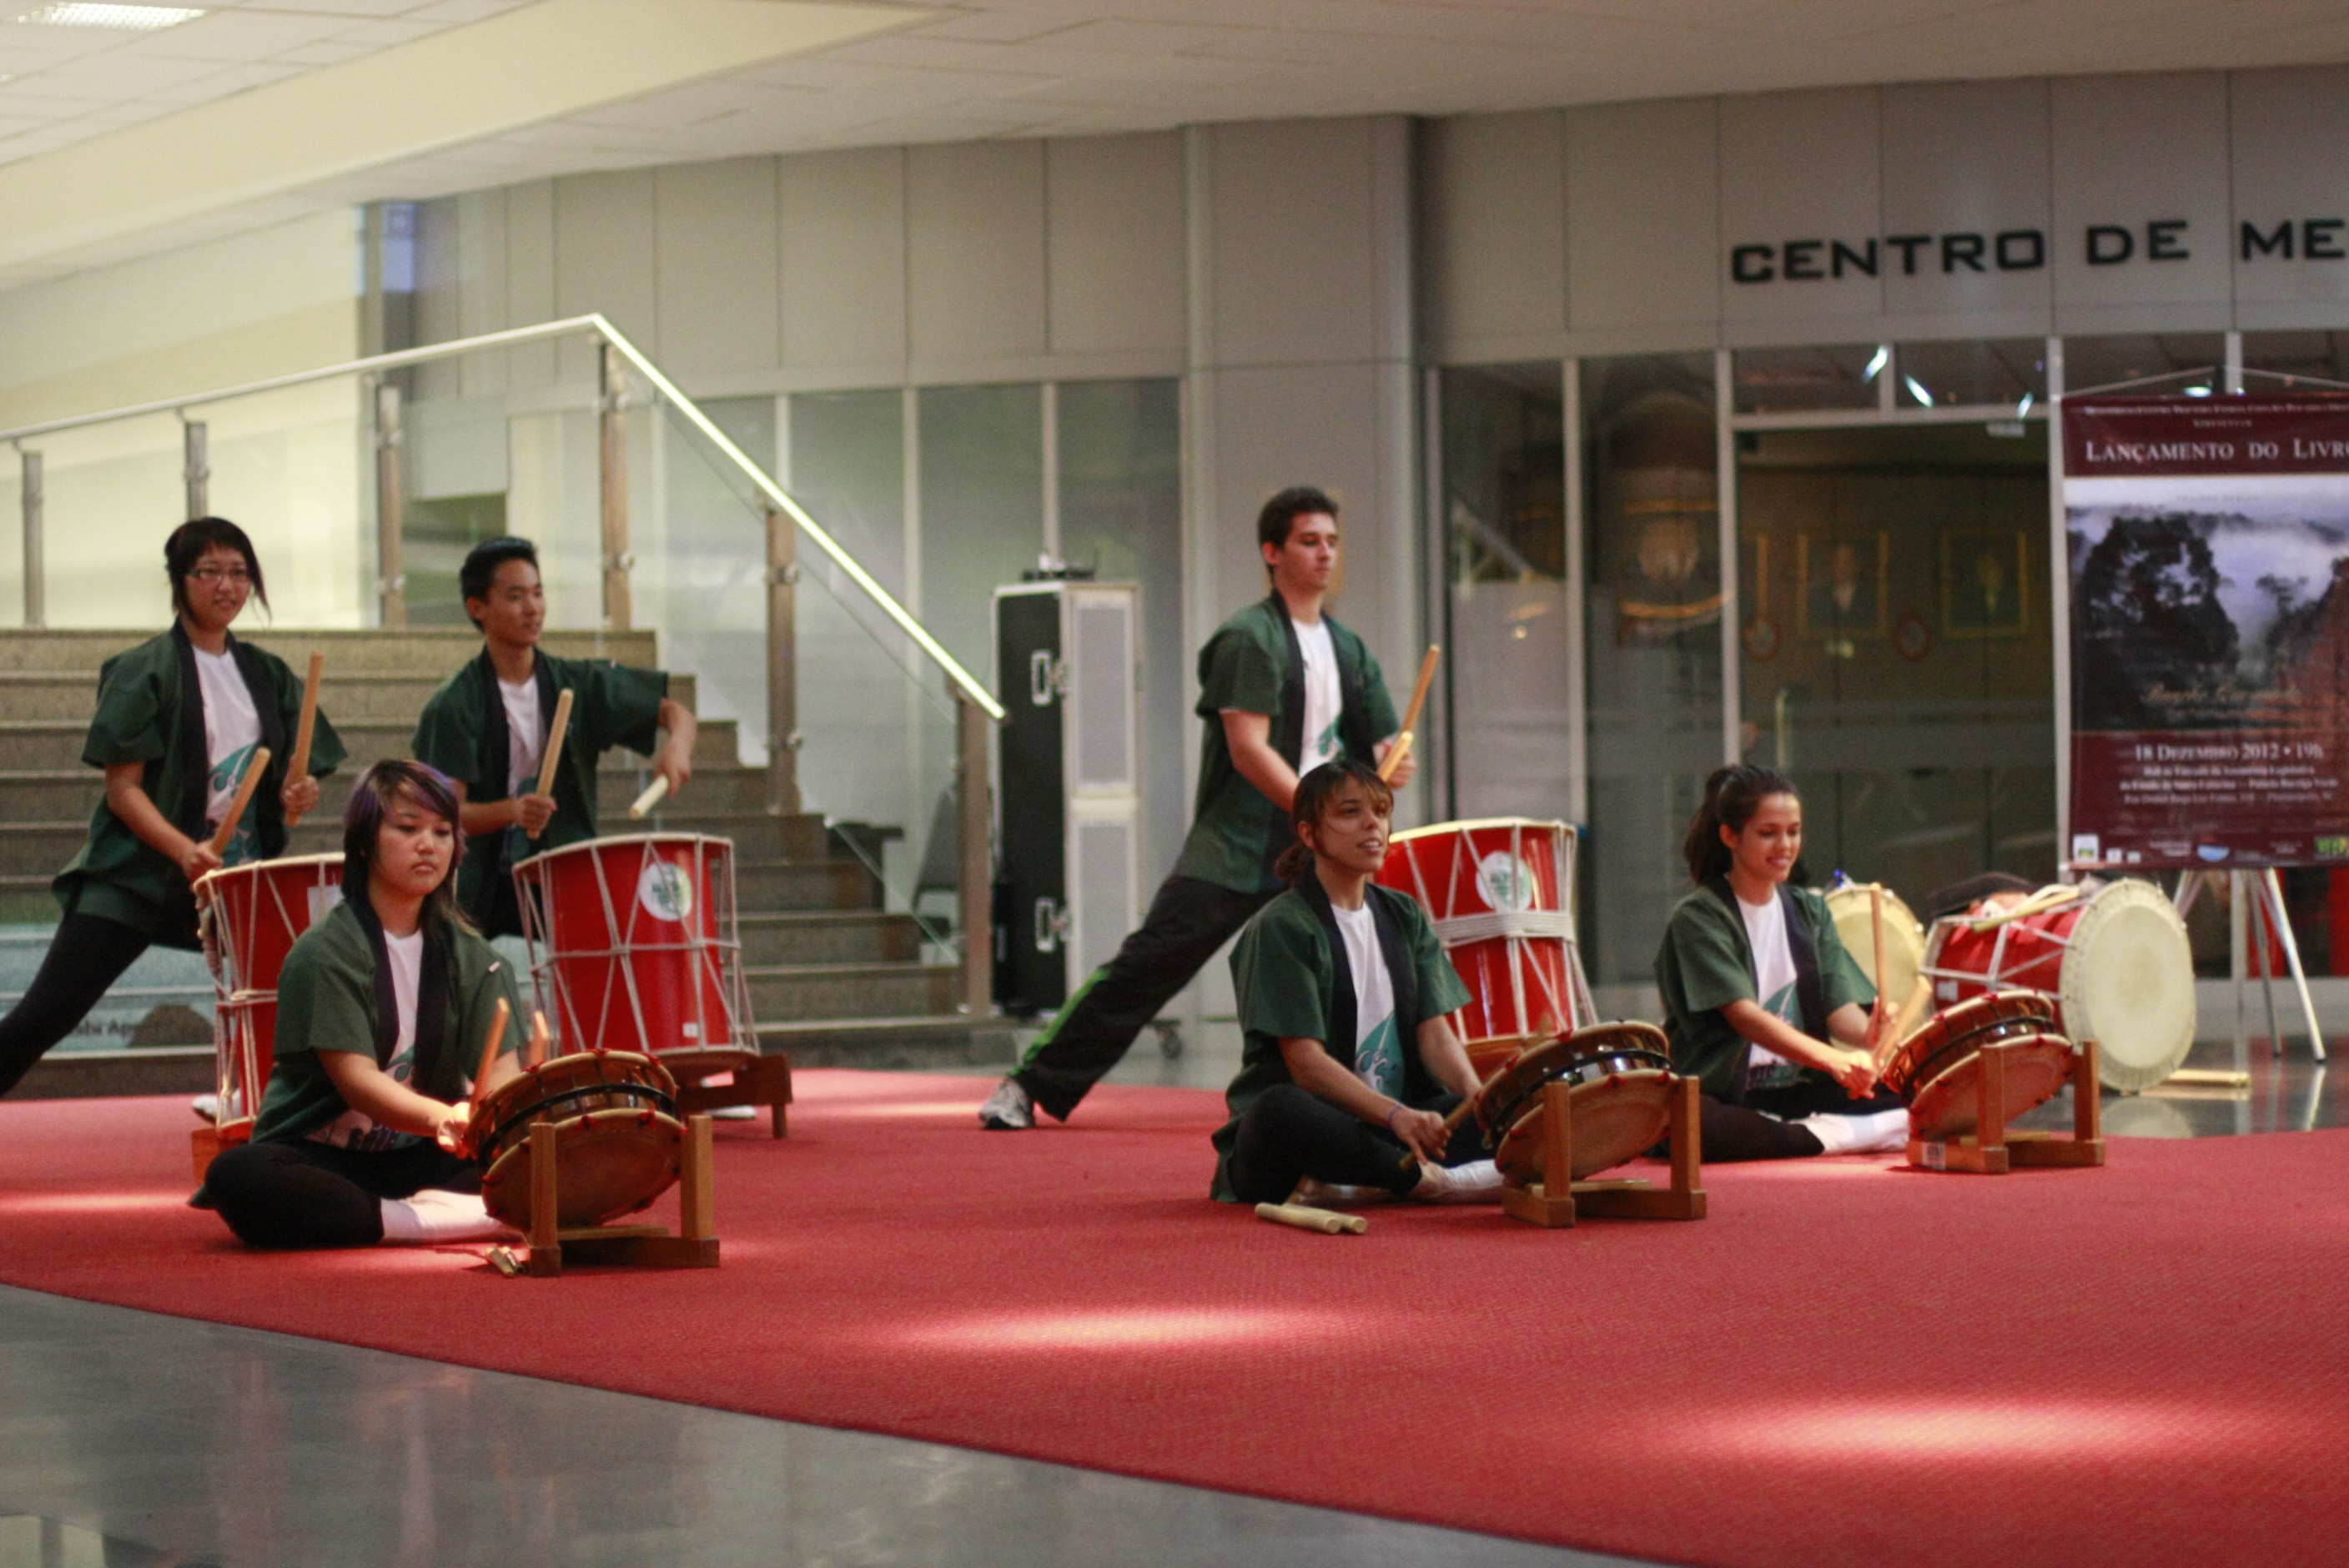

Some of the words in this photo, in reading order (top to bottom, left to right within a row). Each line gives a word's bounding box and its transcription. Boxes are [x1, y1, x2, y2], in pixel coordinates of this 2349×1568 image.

[1732, 229, 2046, 284] CENTRO
[2086, 220, 2190, 266] DE
[2085, 440, 2236, 464] LANÇAMENTO
[2248, 442, 2280, 460] DO
[2242, 743, 2280, 760] 2012
